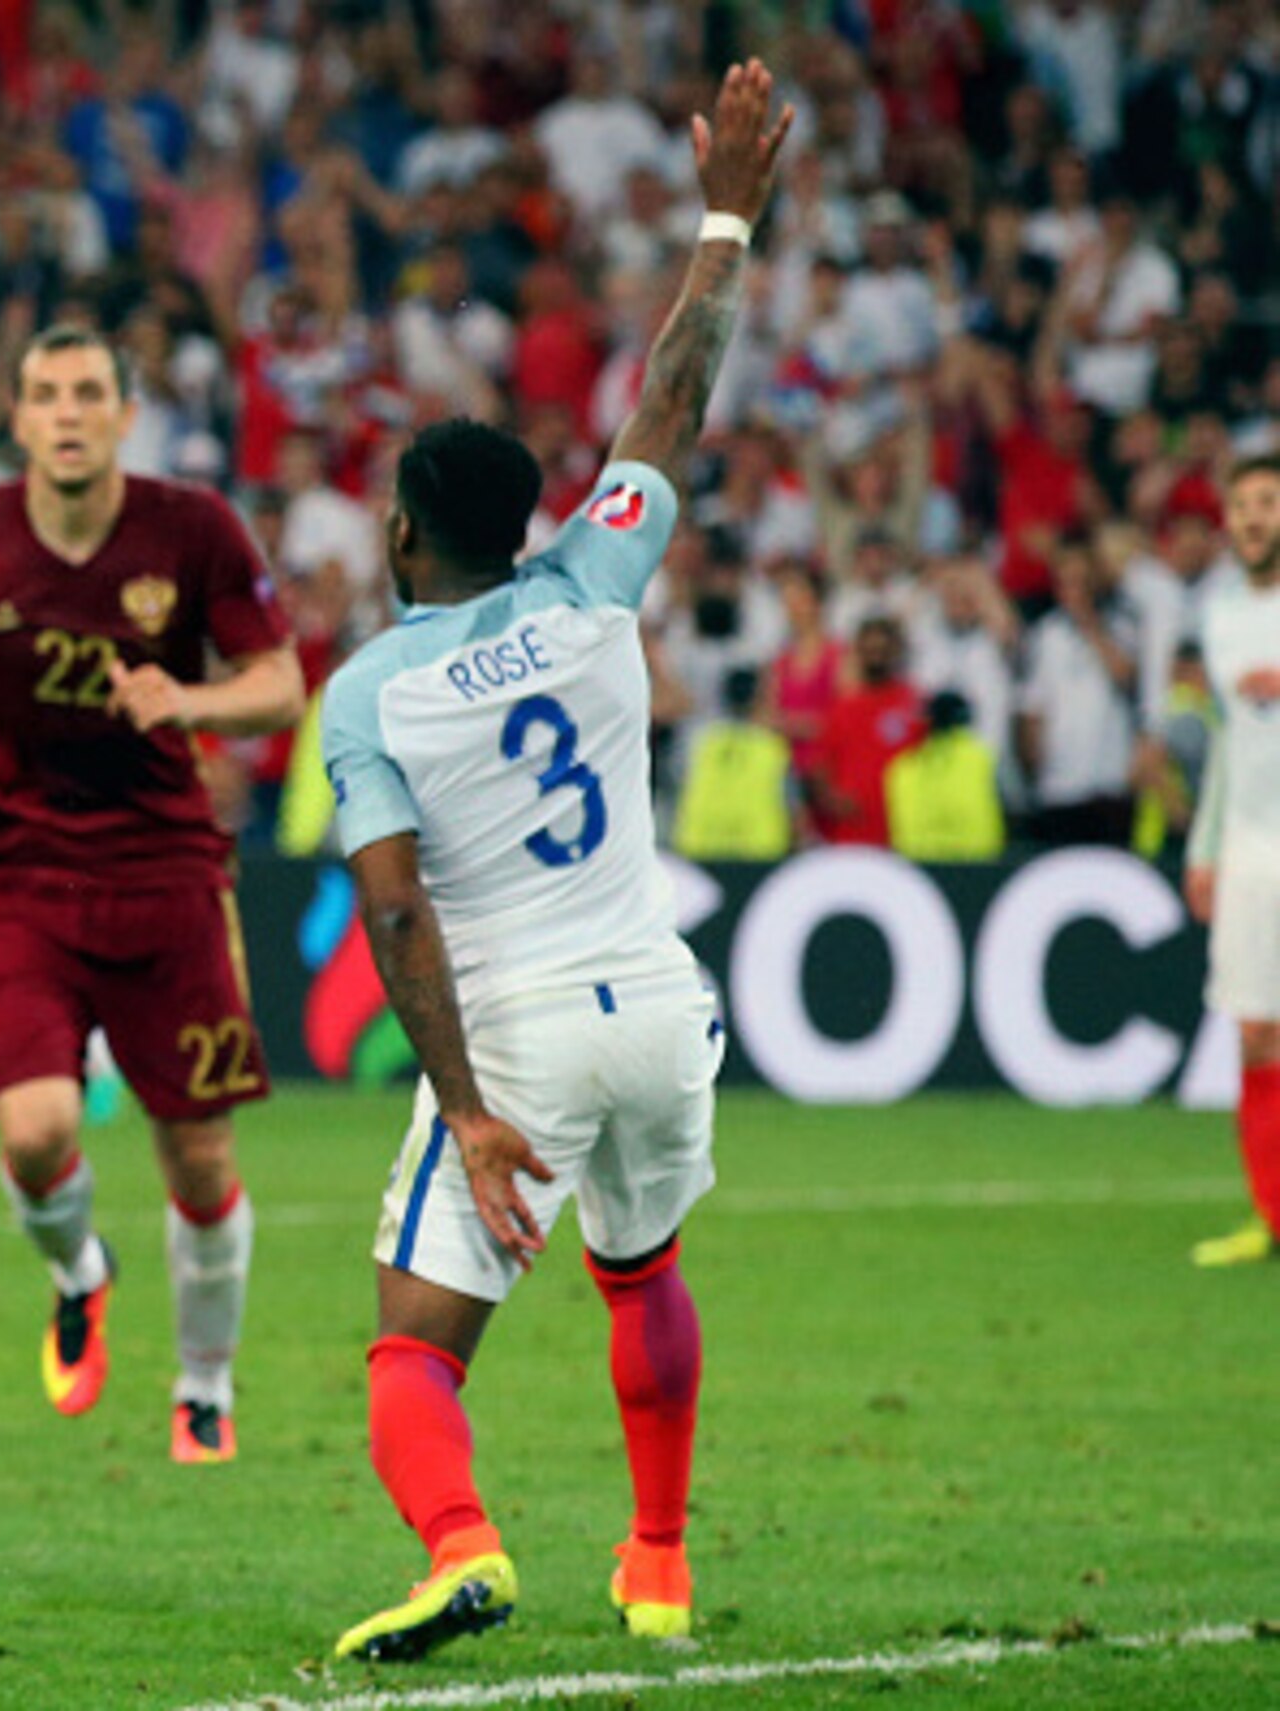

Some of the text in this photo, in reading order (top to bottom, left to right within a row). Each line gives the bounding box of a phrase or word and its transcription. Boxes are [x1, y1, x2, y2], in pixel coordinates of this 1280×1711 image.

[34, 628, 117, 707] 22
[447, 624, 552, 702] ROSE
[500, 693, 607, 868] 3
[177, 1017, 260, 1099] 22
